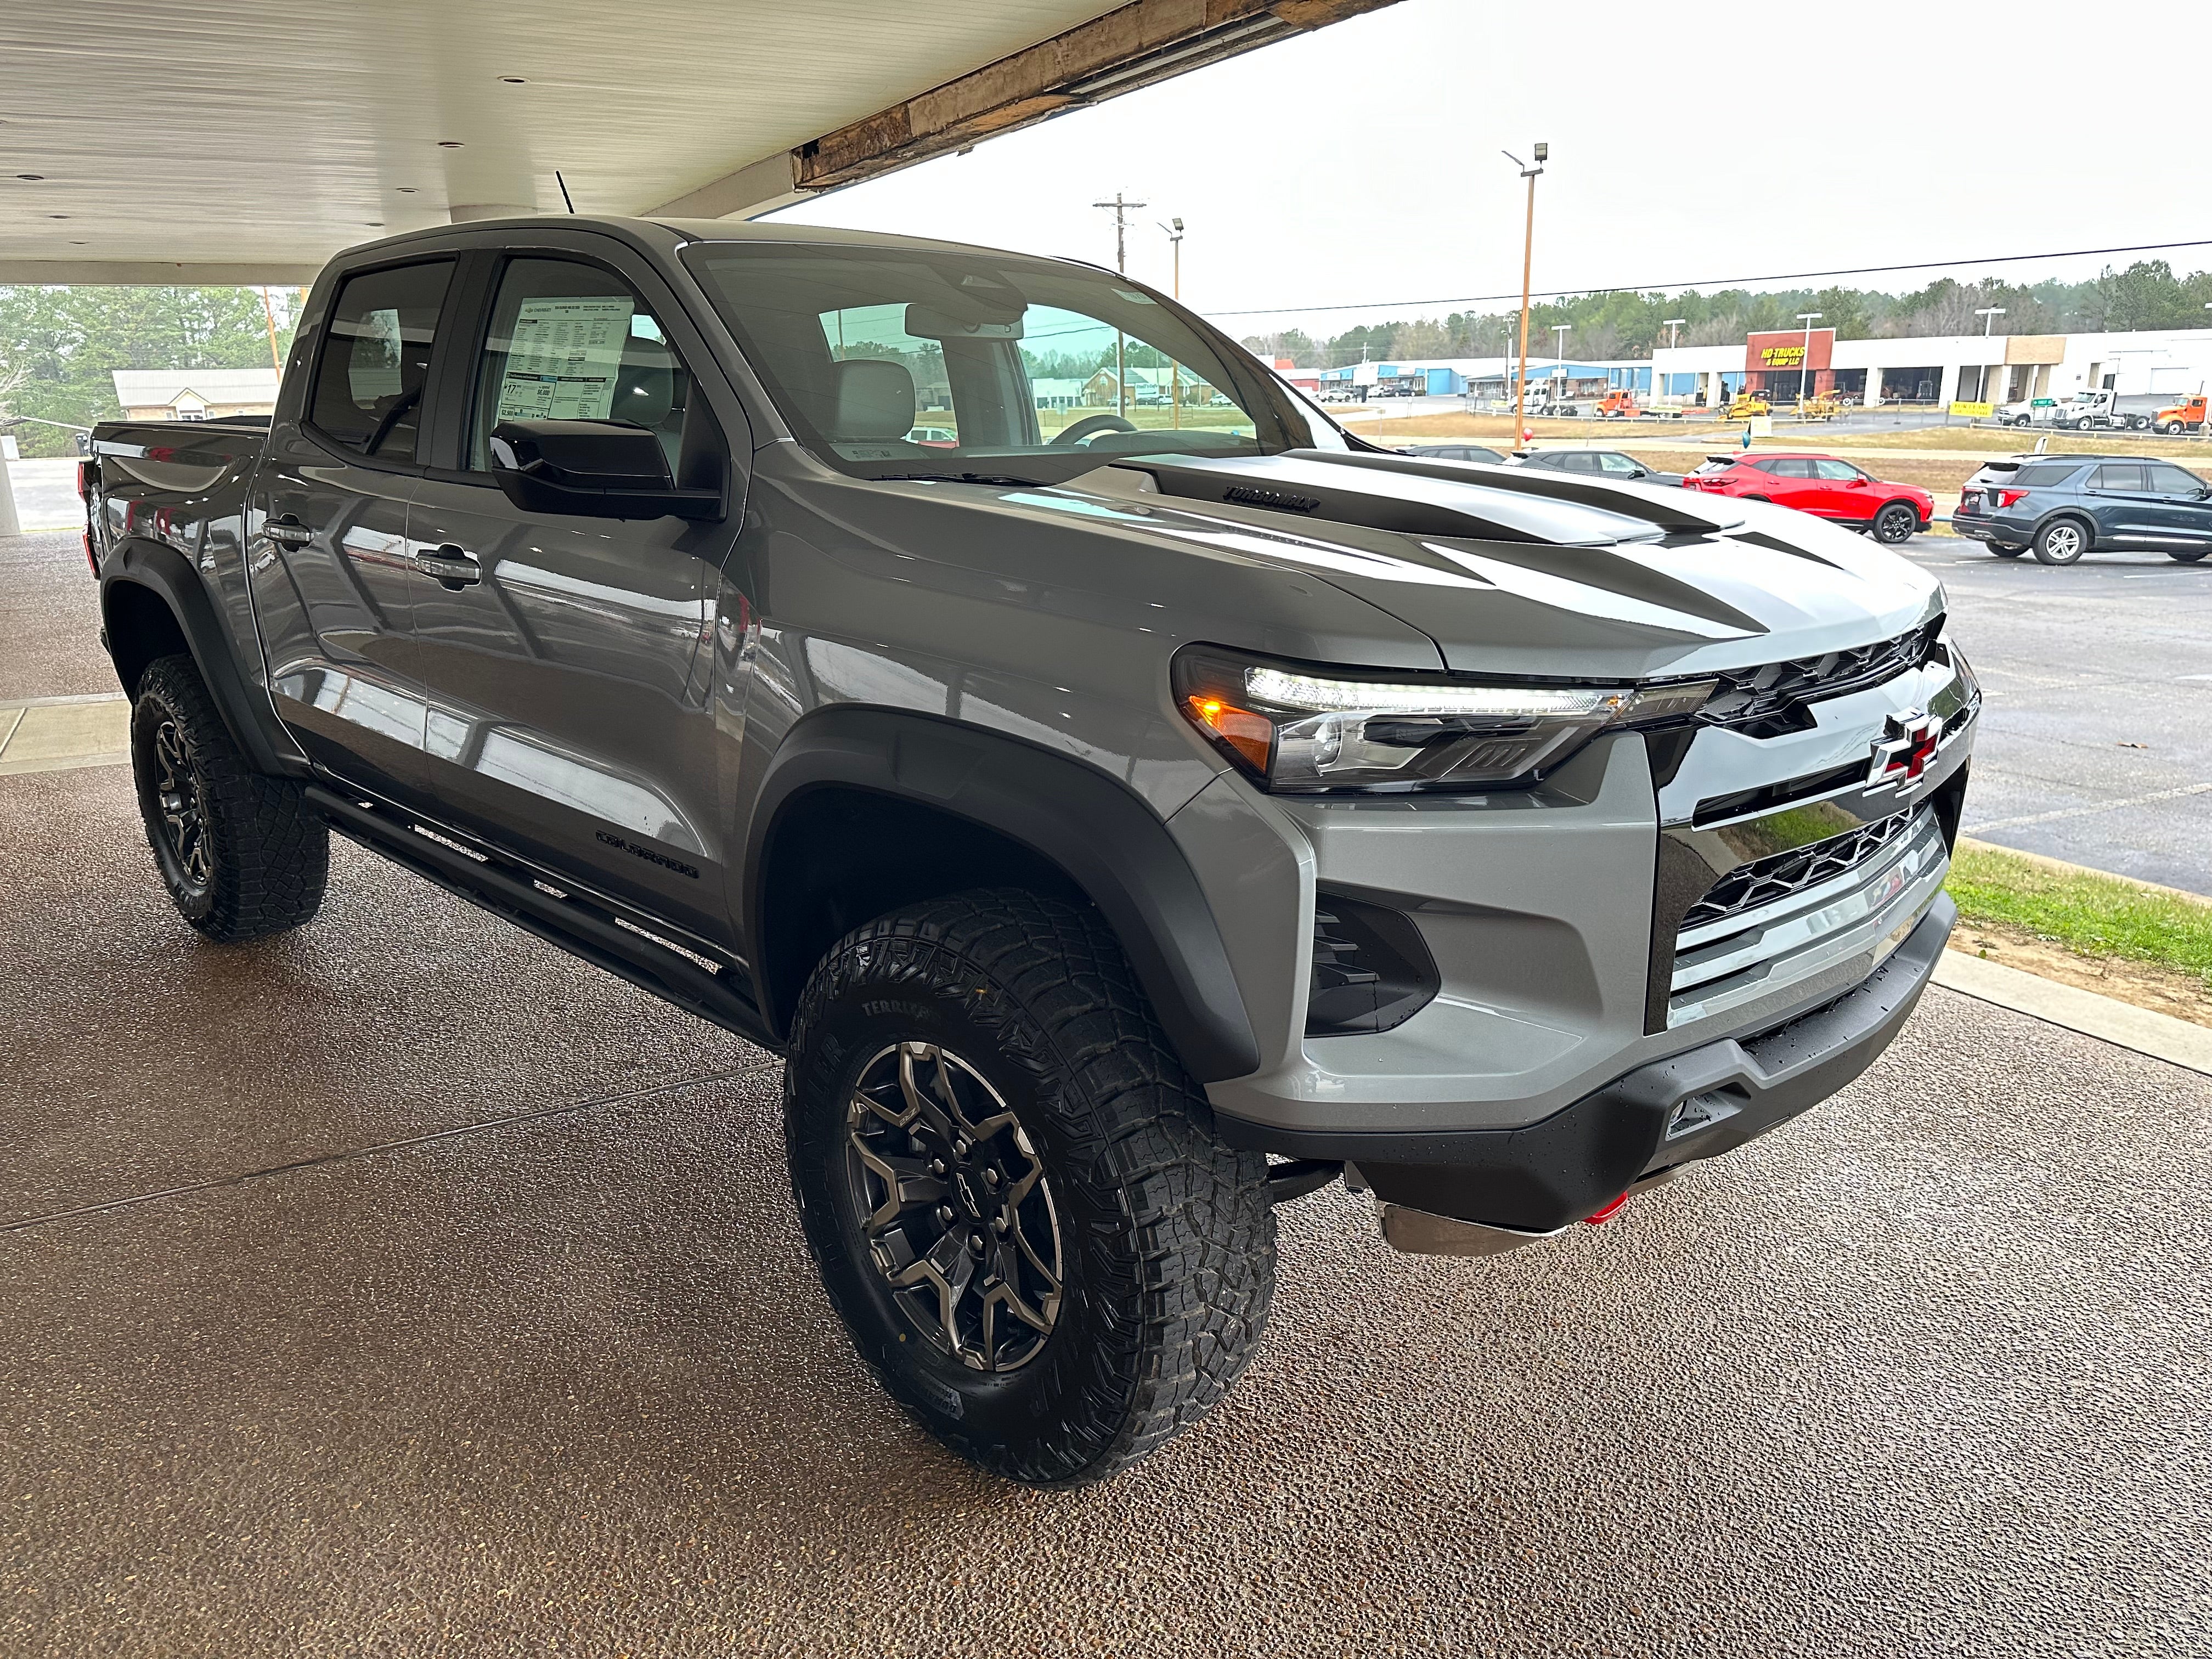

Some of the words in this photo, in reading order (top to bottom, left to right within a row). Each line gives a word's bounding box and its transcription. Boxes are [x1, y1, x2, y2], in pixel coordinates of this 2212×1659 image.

[1771, 358, 1789, 366] EQUIP
[1788, 357, 1800, 365] LLC
[507, 384, 516, 394] 17
[1223, 486, 1312, 512] TURBOMAX
[595, 830, 699, 879] COLORADO
[899, 1107, 918, 1128] ZR2
